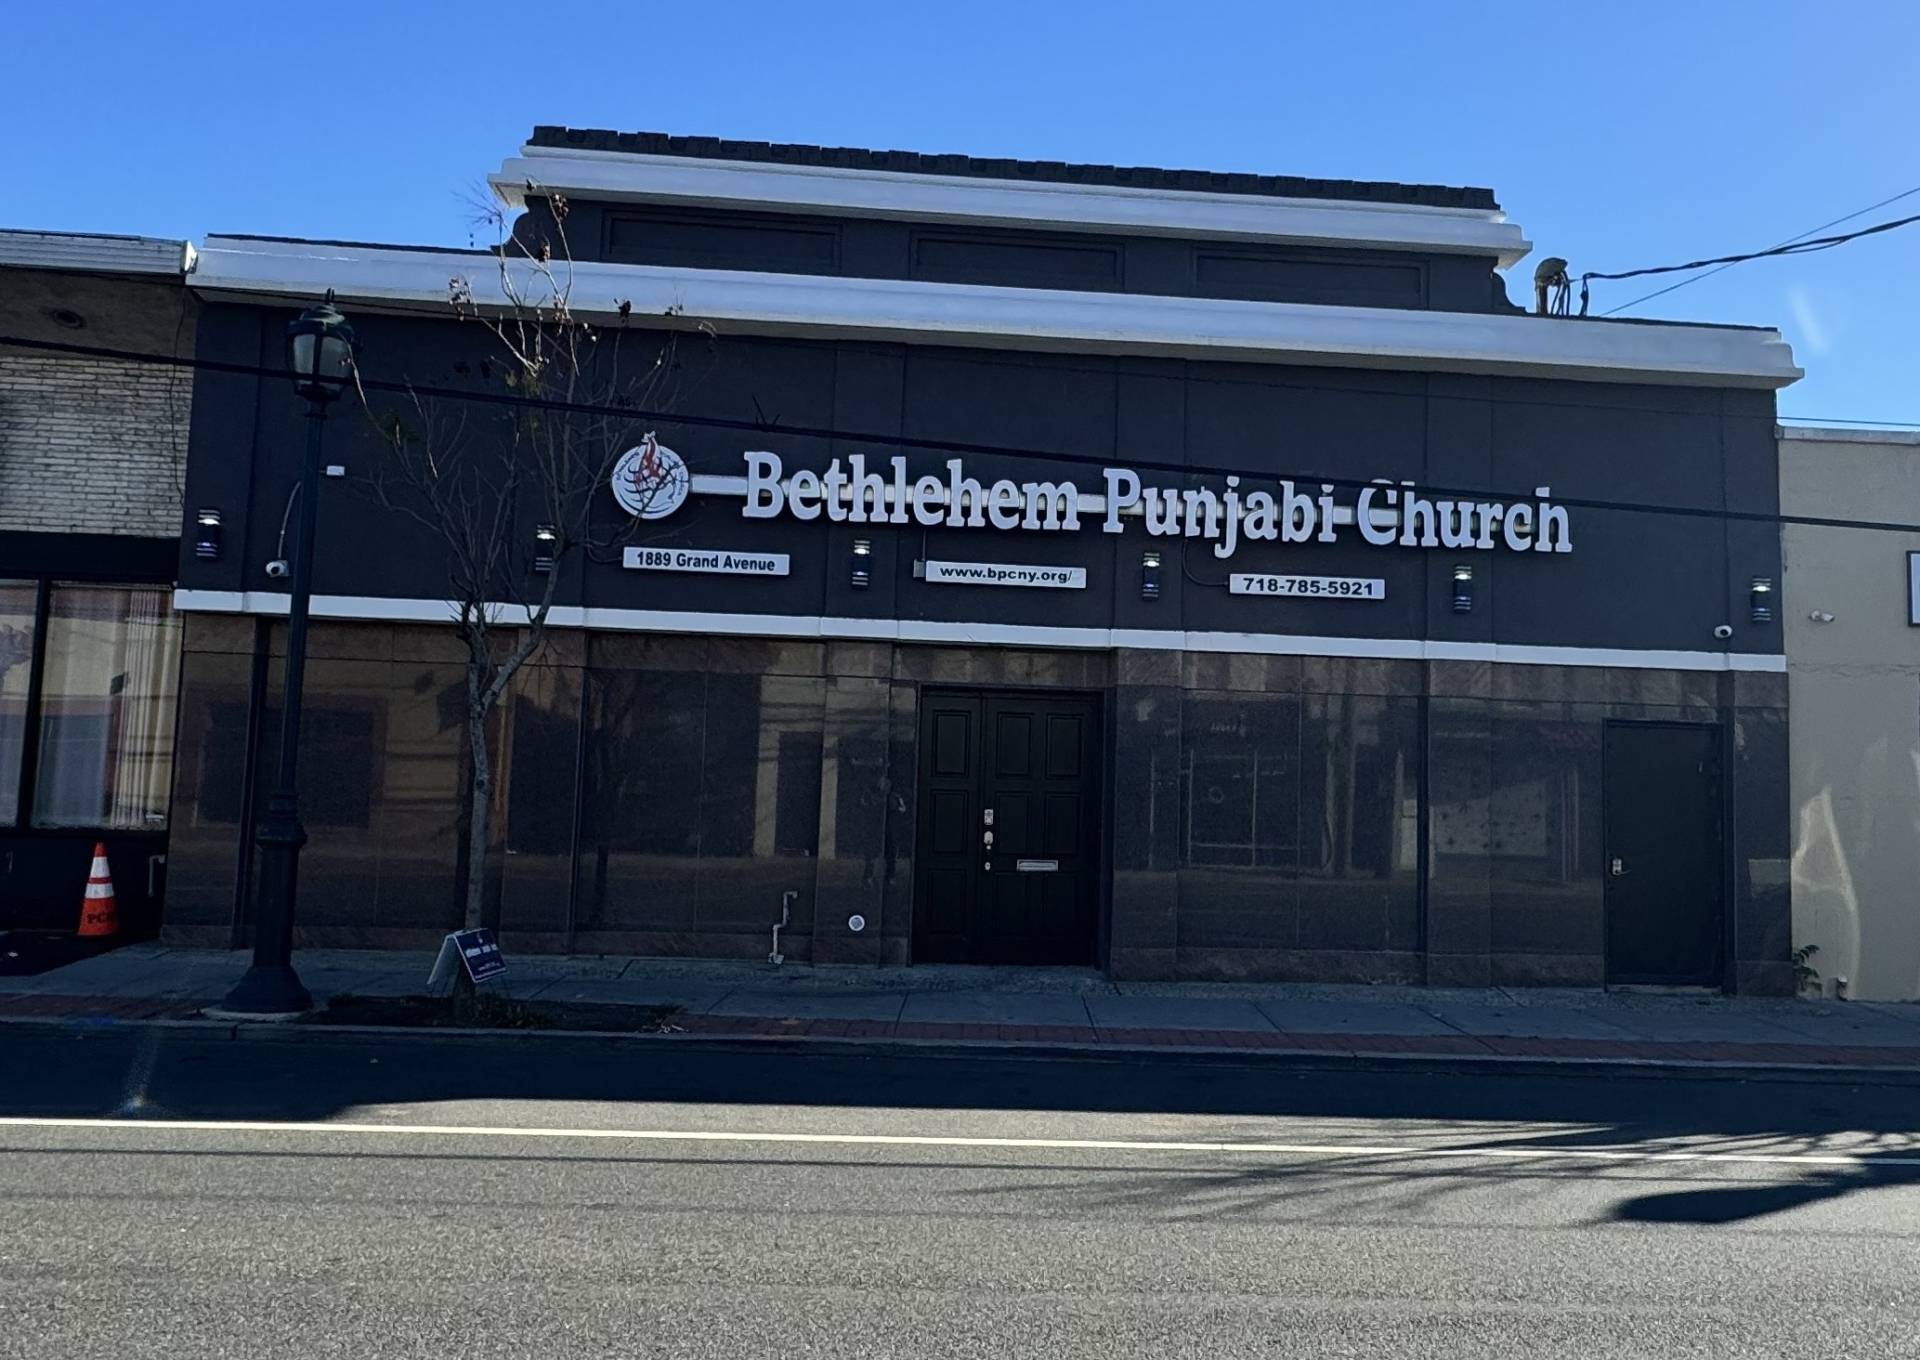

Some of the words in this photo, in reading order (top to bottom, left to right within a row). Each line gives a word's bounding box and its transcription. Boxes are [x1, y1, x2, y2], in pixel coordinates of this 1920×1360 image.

[742, 450, 1081, 531] Bethlehem
[1102, 467, 1338, 559] Punjabi
[1357, 478, 1573, 553] Church
[636, 551, 671, 567] 1889
[676, 553, 719, 568] Grand
[722, 555, 775, 571] Avenue
[940, 567, 1073, 583] www.bpcny.org/
[1243, 577, 1374, 596] 718-785-5921
